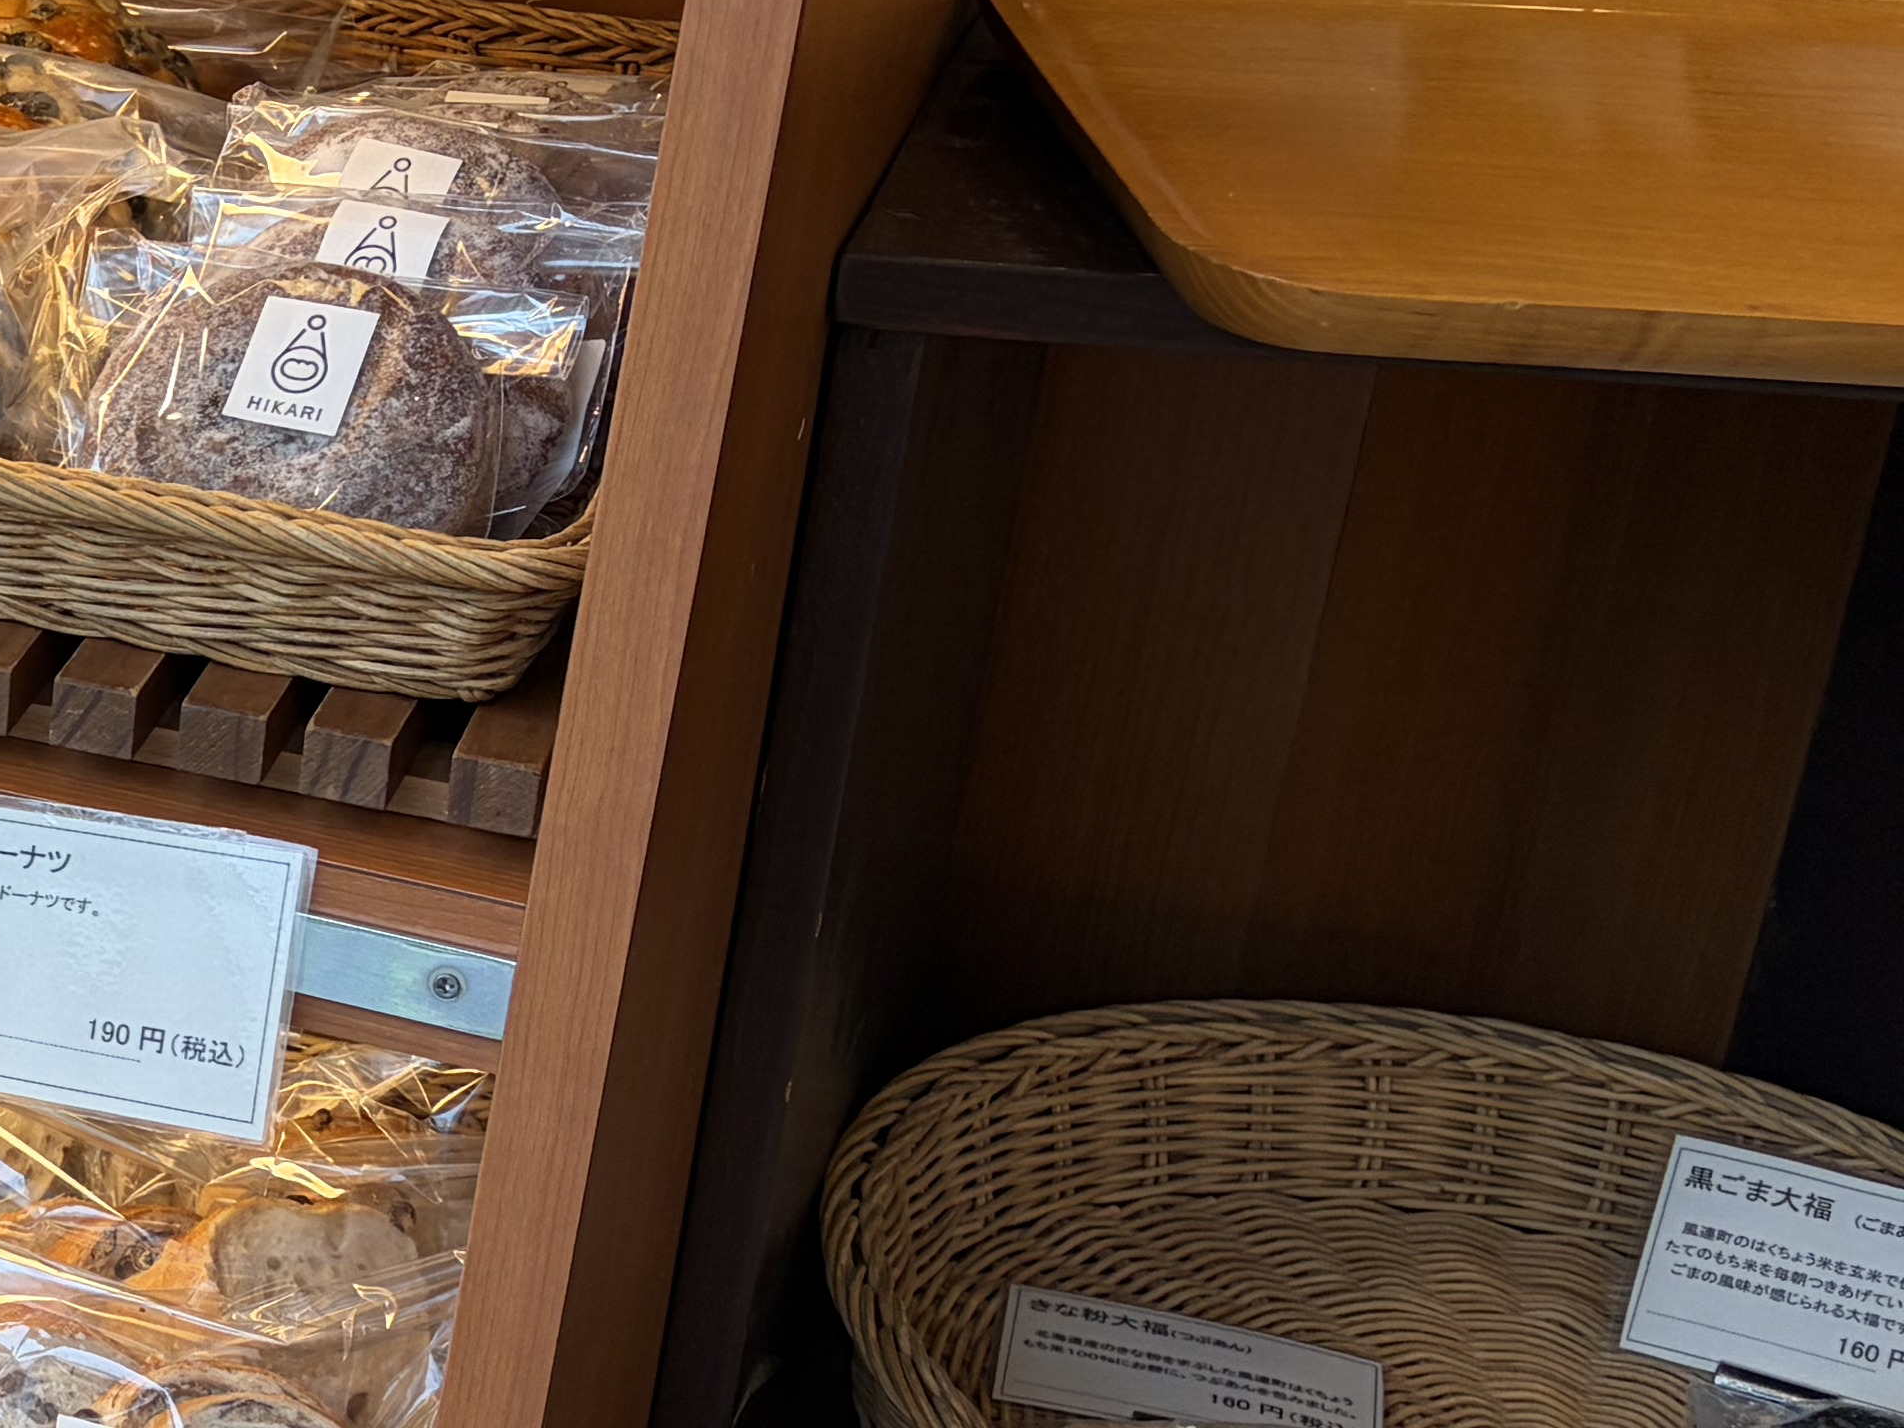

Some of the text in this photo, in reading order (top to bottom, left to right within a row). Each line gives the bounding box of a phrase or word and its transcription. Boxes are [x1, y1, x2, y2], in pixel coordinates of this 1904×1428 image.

[247, 395, 323, 422] HIKARI
[1684, 1164, 1836, 1222] 黒ごま大福
